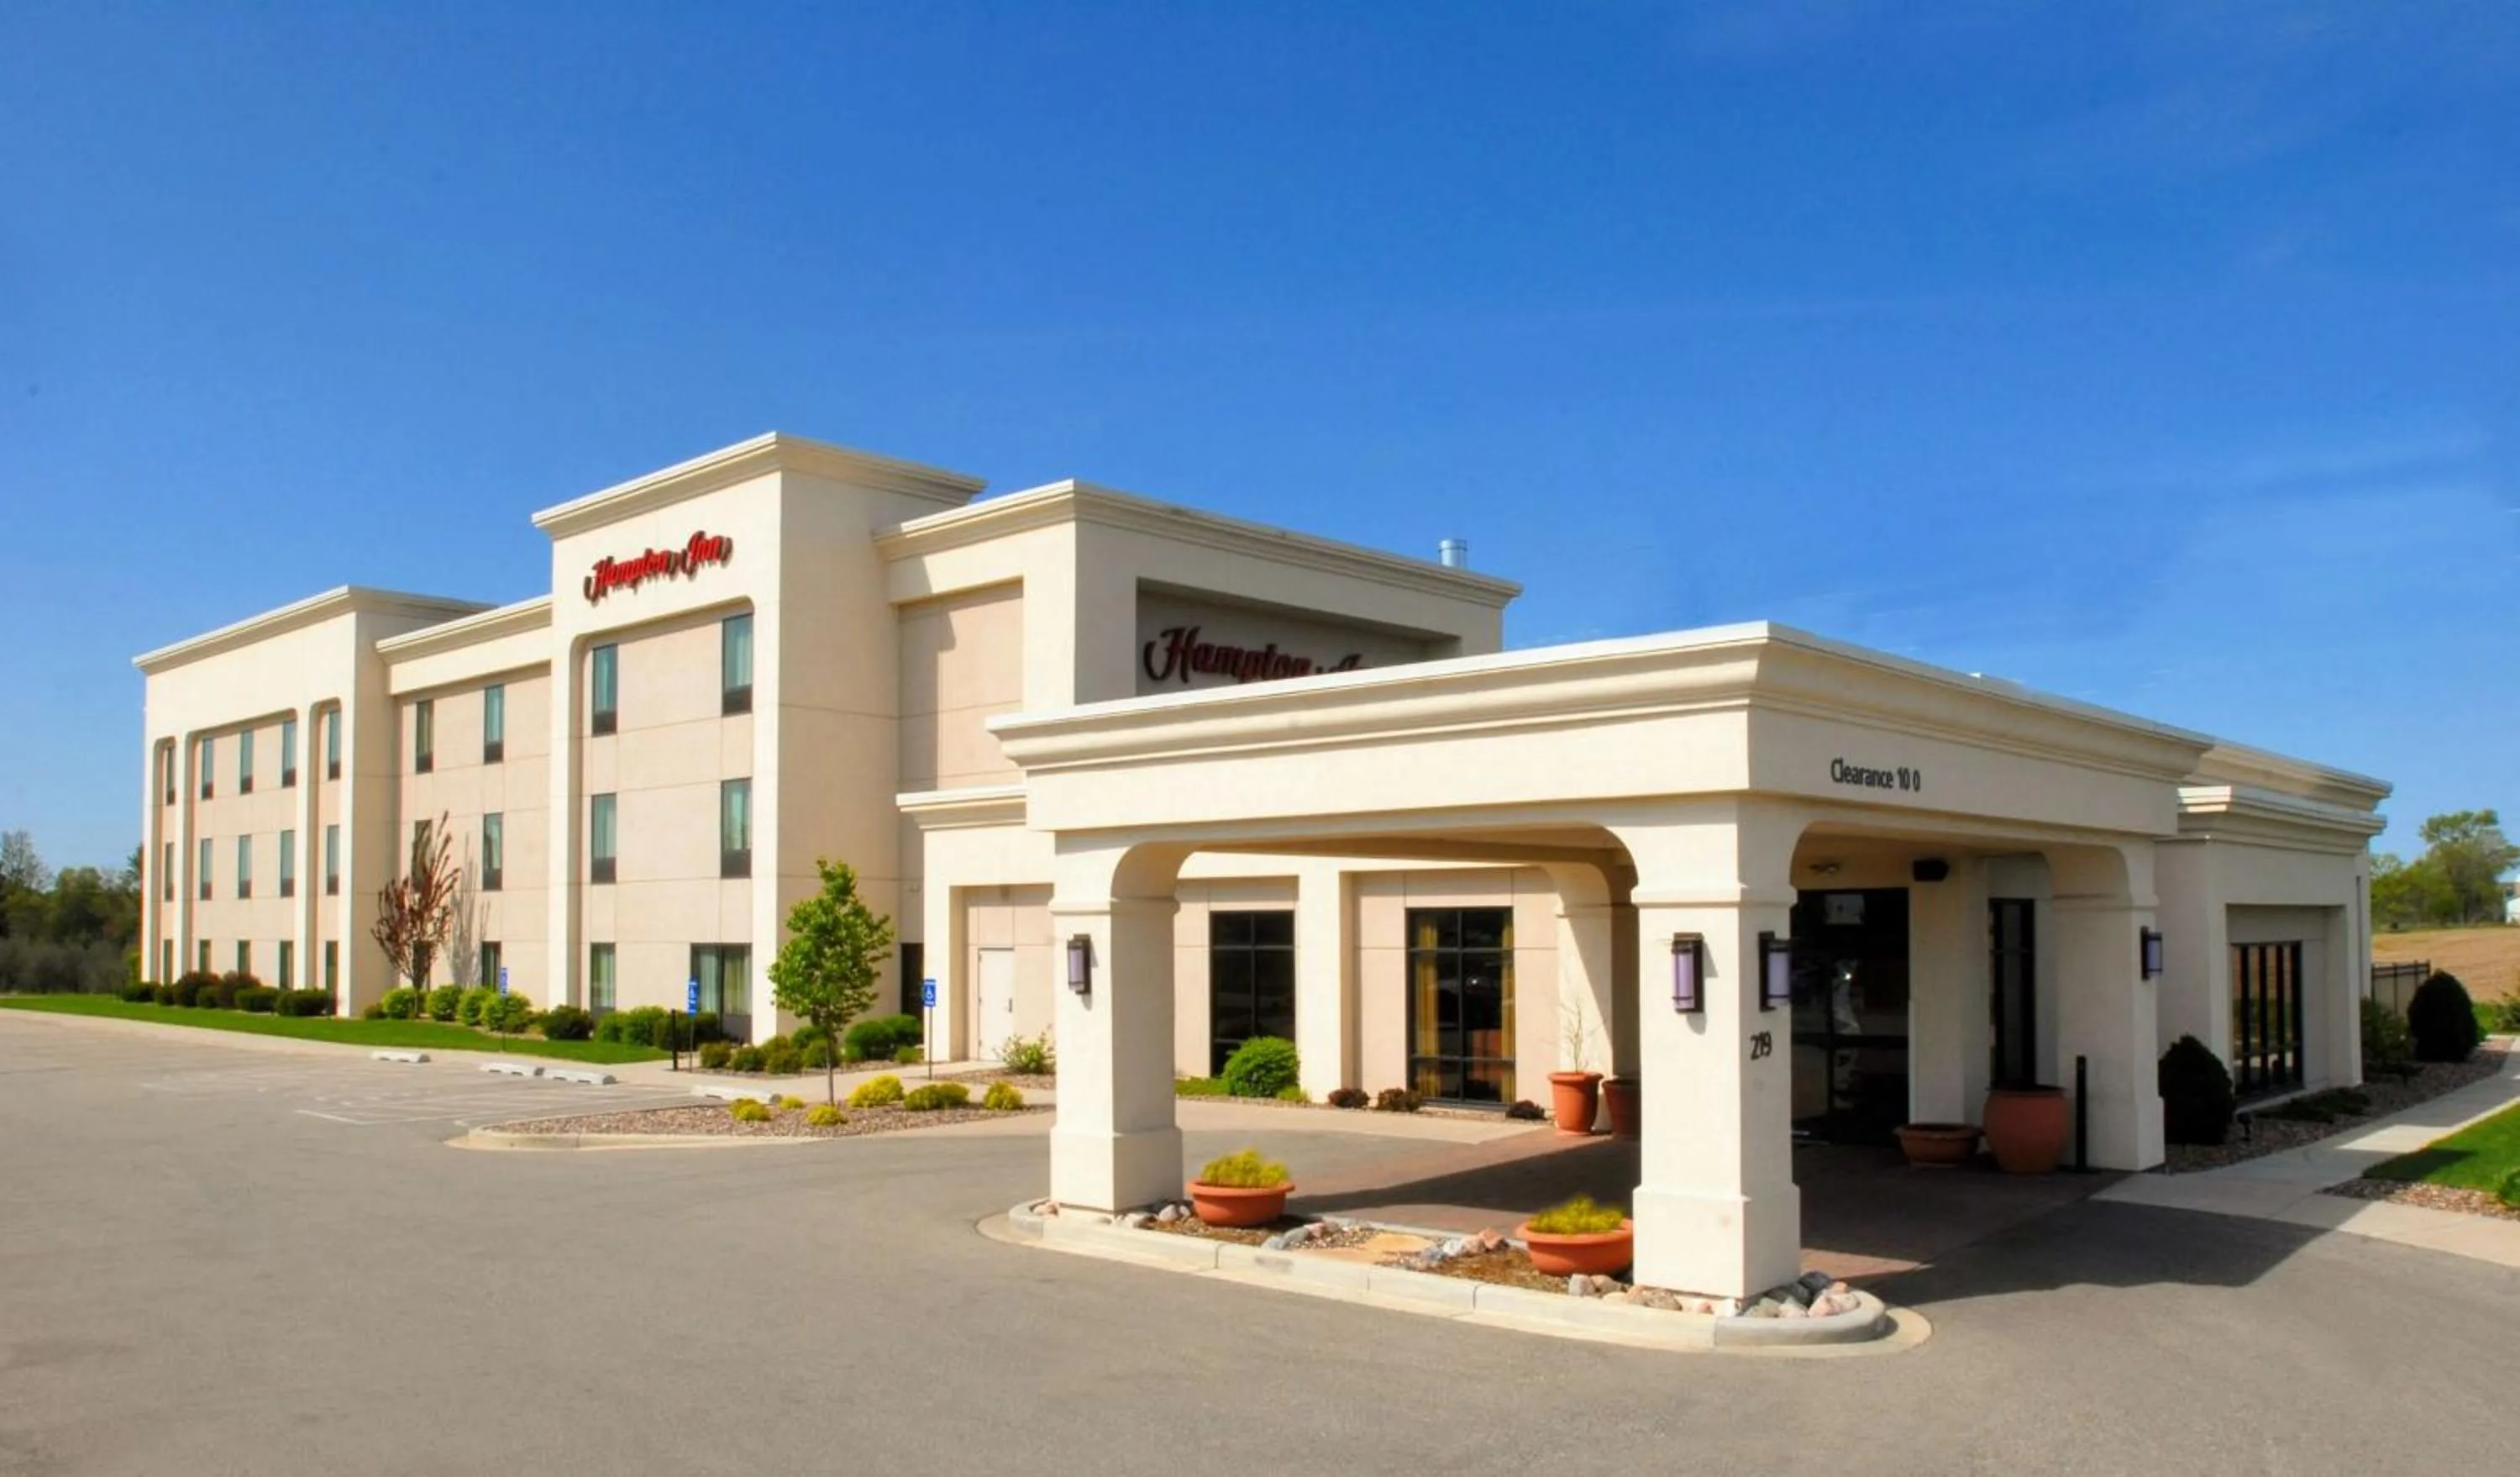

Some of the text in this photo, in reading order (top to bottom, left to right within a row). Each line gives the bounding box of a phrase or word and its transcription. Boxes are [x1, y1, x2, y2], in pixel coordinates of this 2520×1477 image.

[583, 530, 733, 607] Hampton Inn
[1143, 626, 1313, 685] Hampton
[1830, 757, 1894, 789] Clearance
[1750, 1031, 1772, 1060] 219
